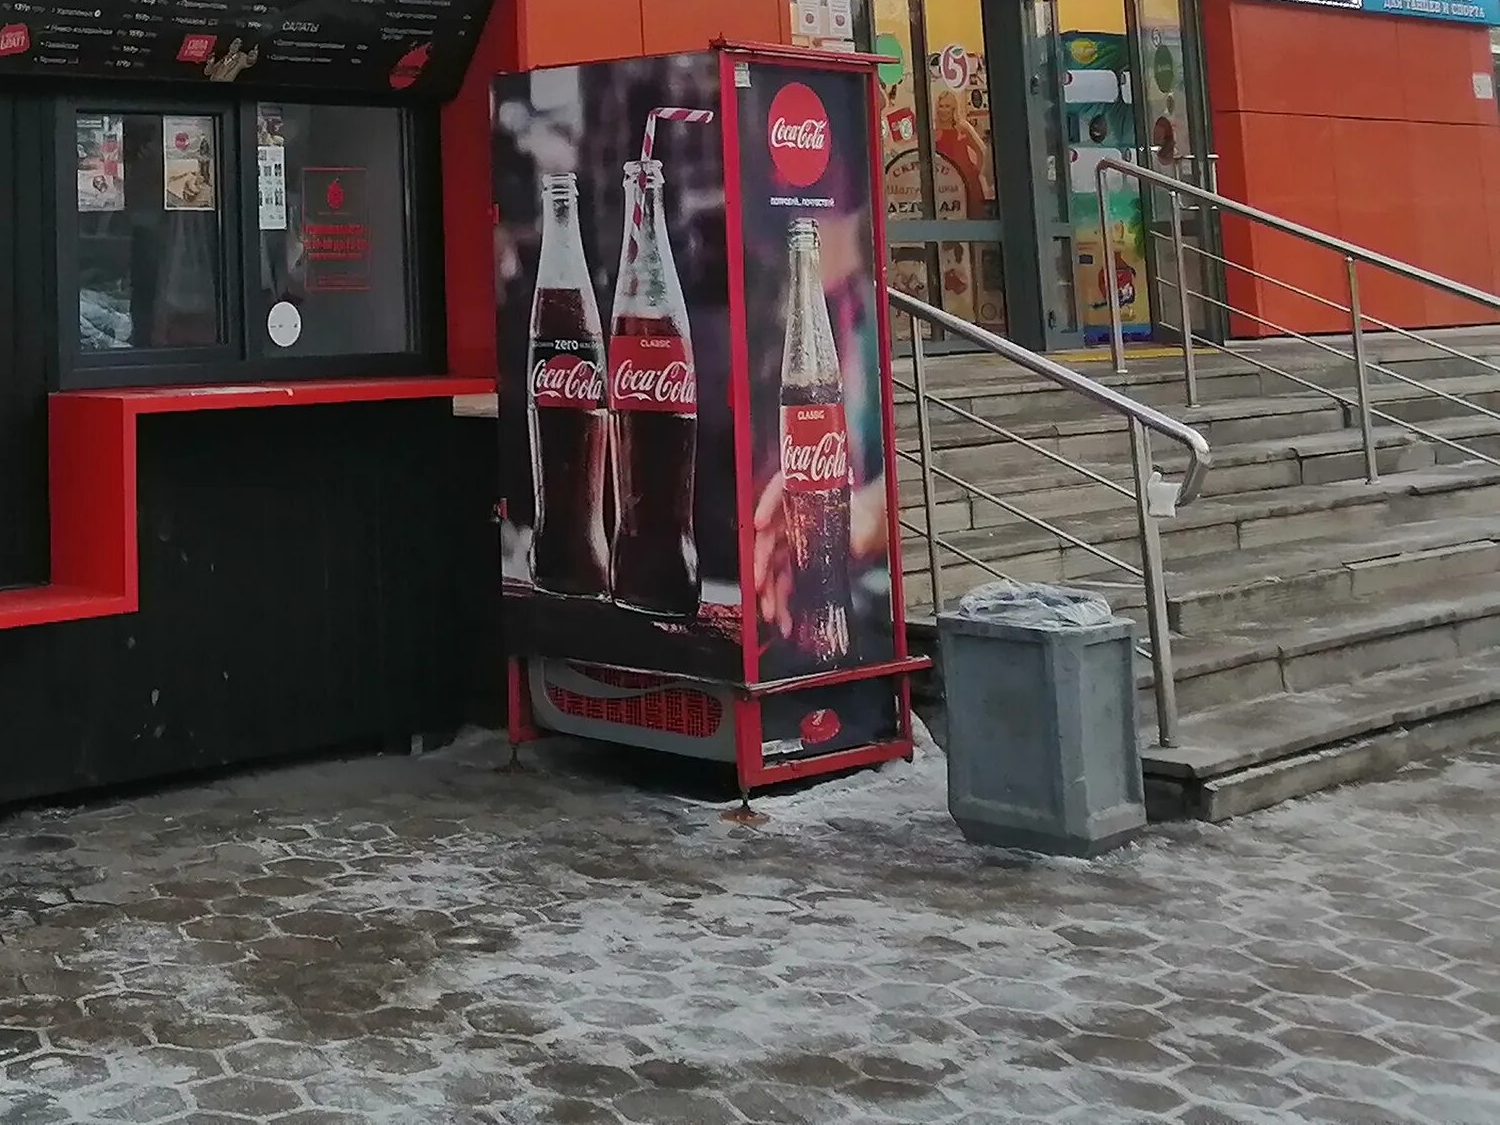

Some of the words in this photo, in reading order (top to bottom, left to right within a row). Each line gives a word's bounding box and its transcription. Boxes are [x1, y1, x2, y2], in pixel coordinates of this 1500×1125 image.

[282, 21, 320, 34] САЛАТЫ
[771, 117, 828, 150] Coca-Cola
[554, 339, 579, 351] zero
[531, 358, 603, 401] Coca-Cola
[614, 358, 698, 404] Coca-Cola
[781, 430, 848, 482] Coca-Cola
